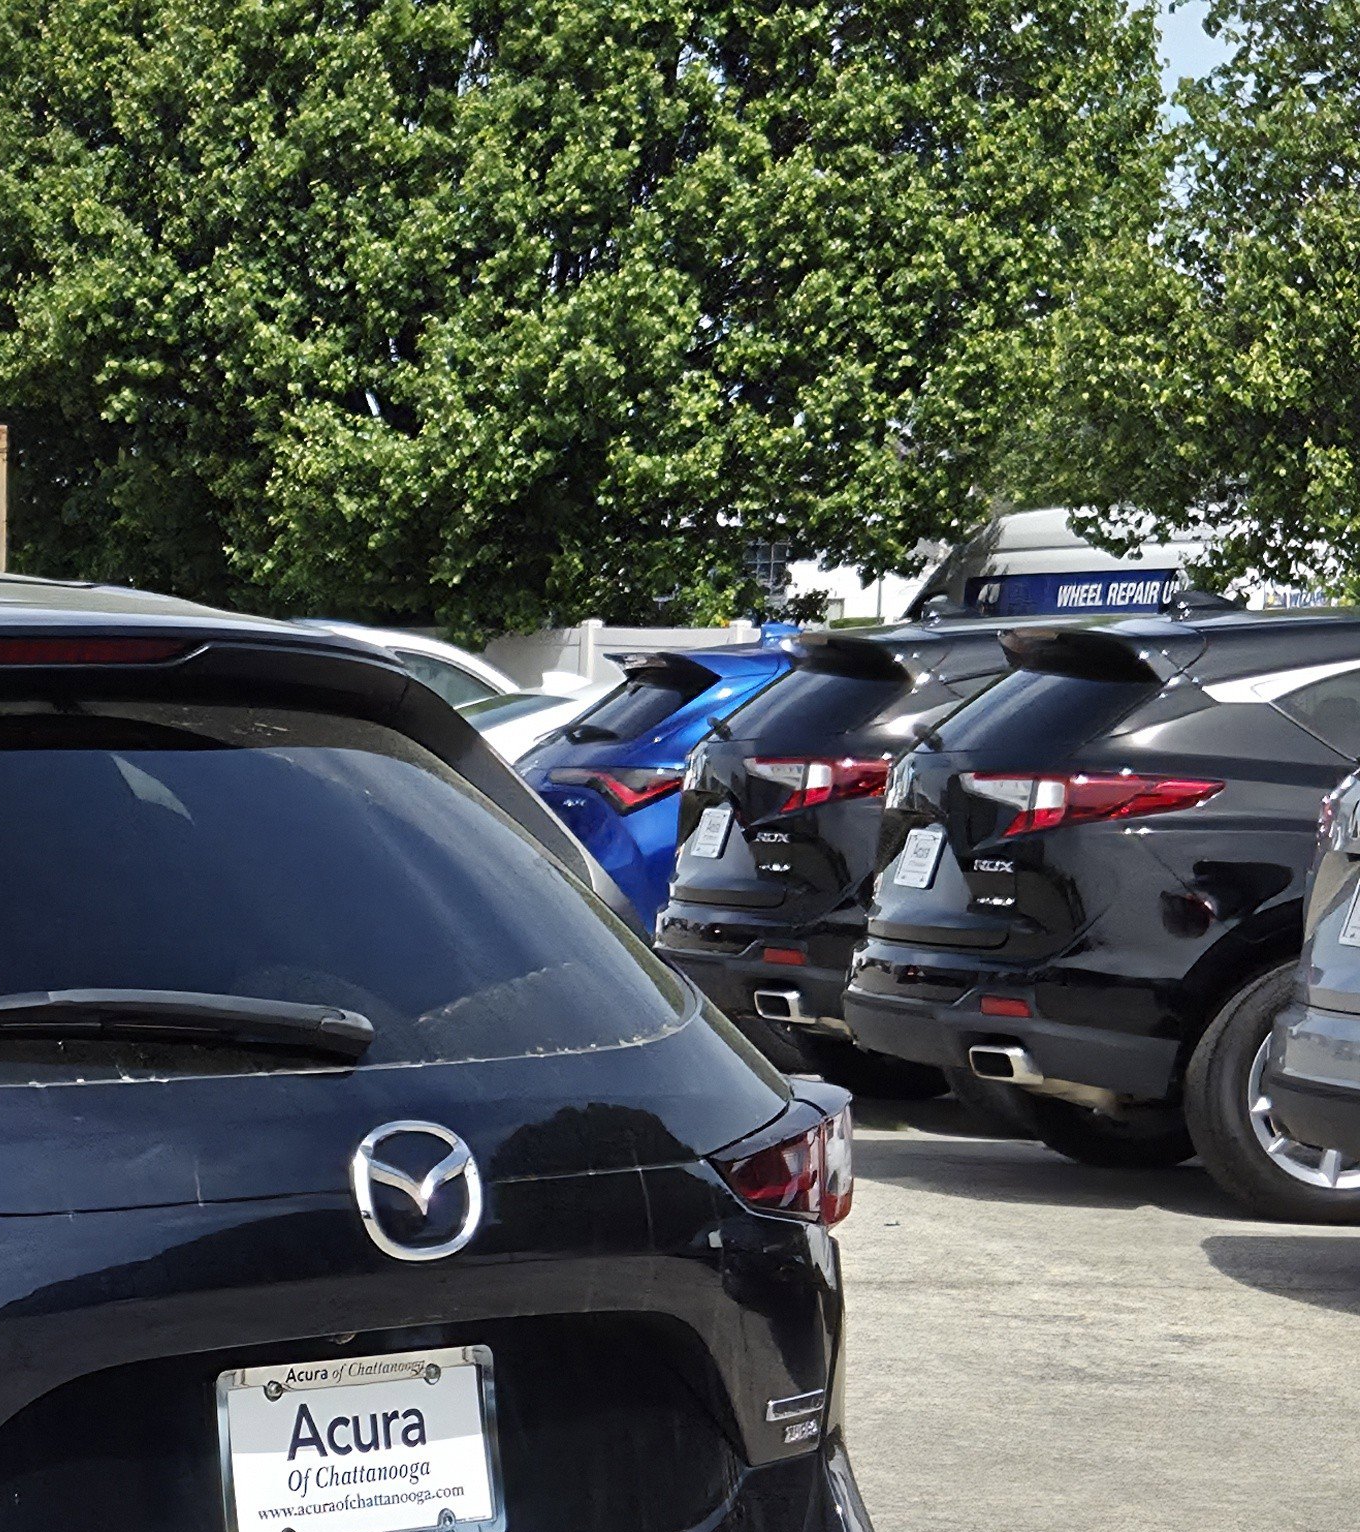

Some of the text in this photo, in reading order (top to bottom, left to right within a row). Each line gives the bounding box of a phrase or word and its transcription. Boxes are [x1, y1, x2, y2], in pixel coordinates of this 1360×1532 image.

[1056, 582, 1103, 608] WHEEL
[1106, 581, 1160, 606] REPAIR
[973, 859, 1014, 873] RDX
[285, 1367, 329, 1383] Acura
[332, 1363, 347, 1383] of
[286, 1403, 428, 1462] Acura
[287, 1460, 431, 1498] Of Chattanooga
[257, 1485, 465, 1520] www.acuraofchattanooga.com
